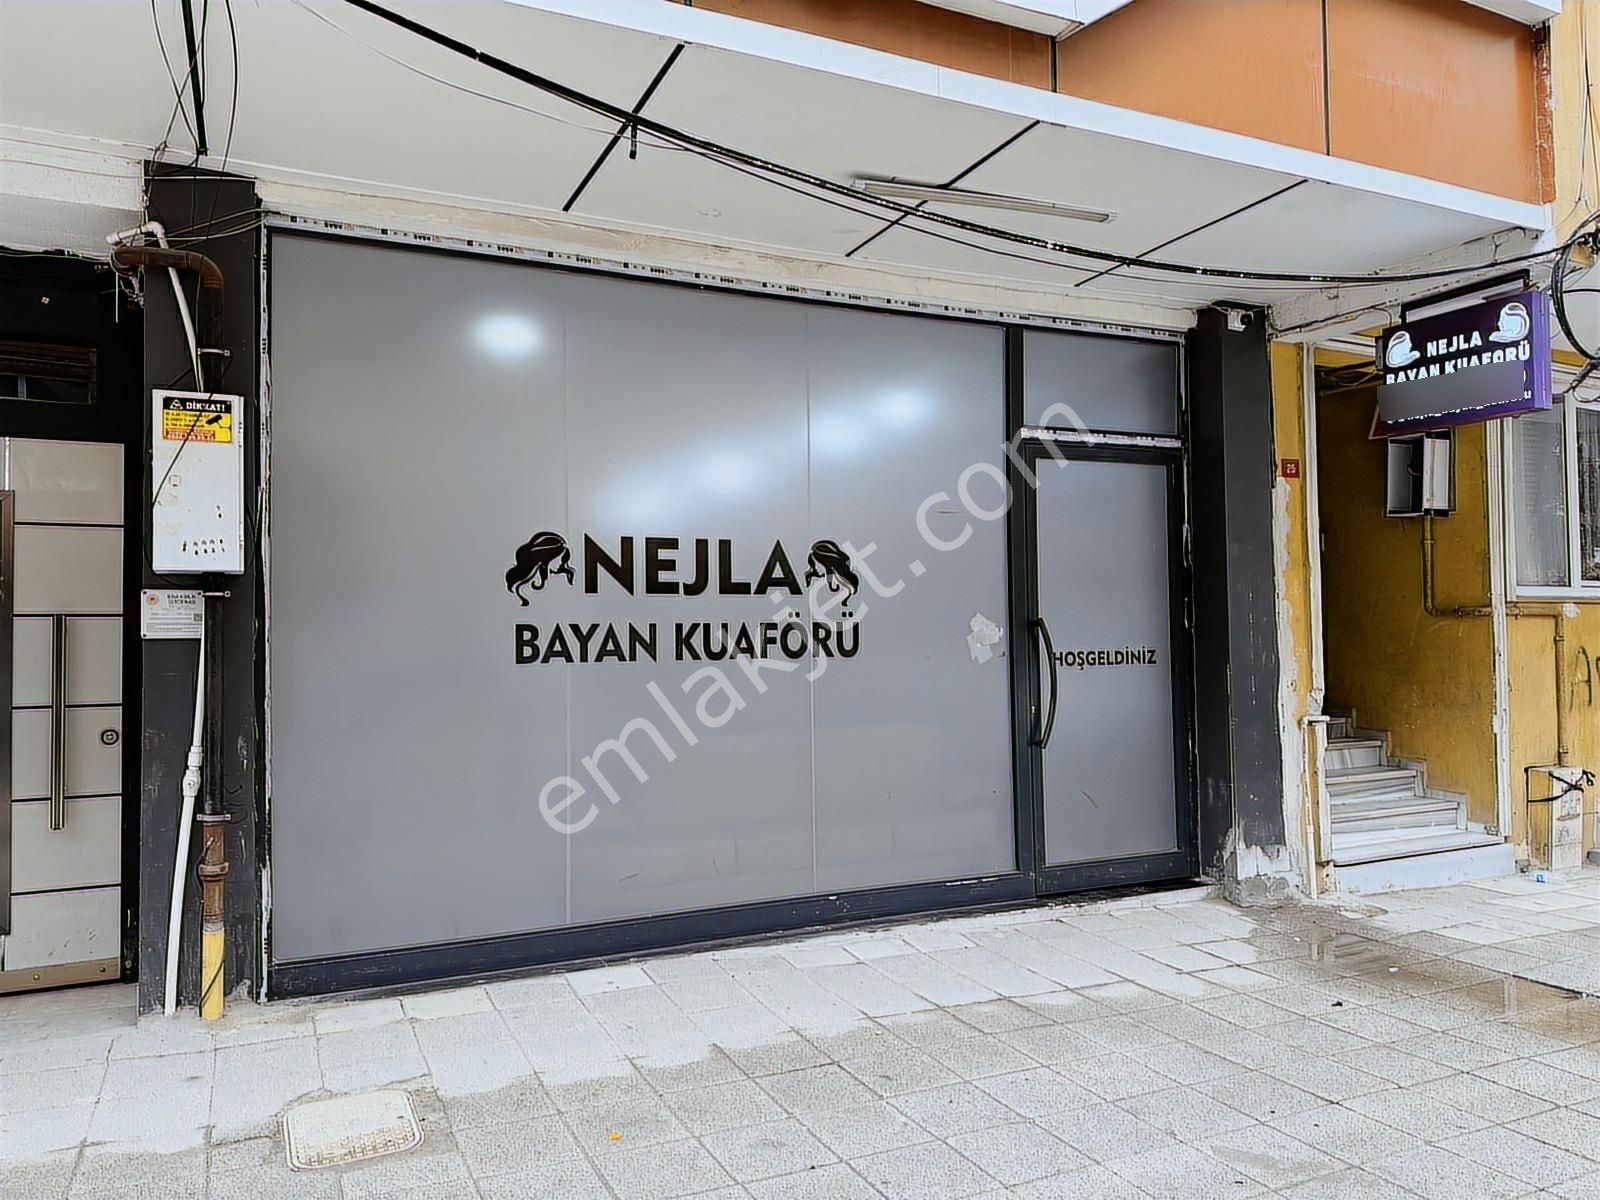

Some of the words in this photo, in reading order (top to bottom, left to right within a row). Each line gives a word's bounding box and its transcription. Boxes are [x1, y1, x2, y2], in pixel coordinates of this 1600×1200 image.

[1426, 330, 1483, 358] NEJLA
[583, 533, 803, 596] NEJLA
[514, 621, 658, 665] BAYAN
[674, 610, 862, 662] KUAFÖRÜ
[1053, 645, 1158, 671] HOŞGELDİNİZ
